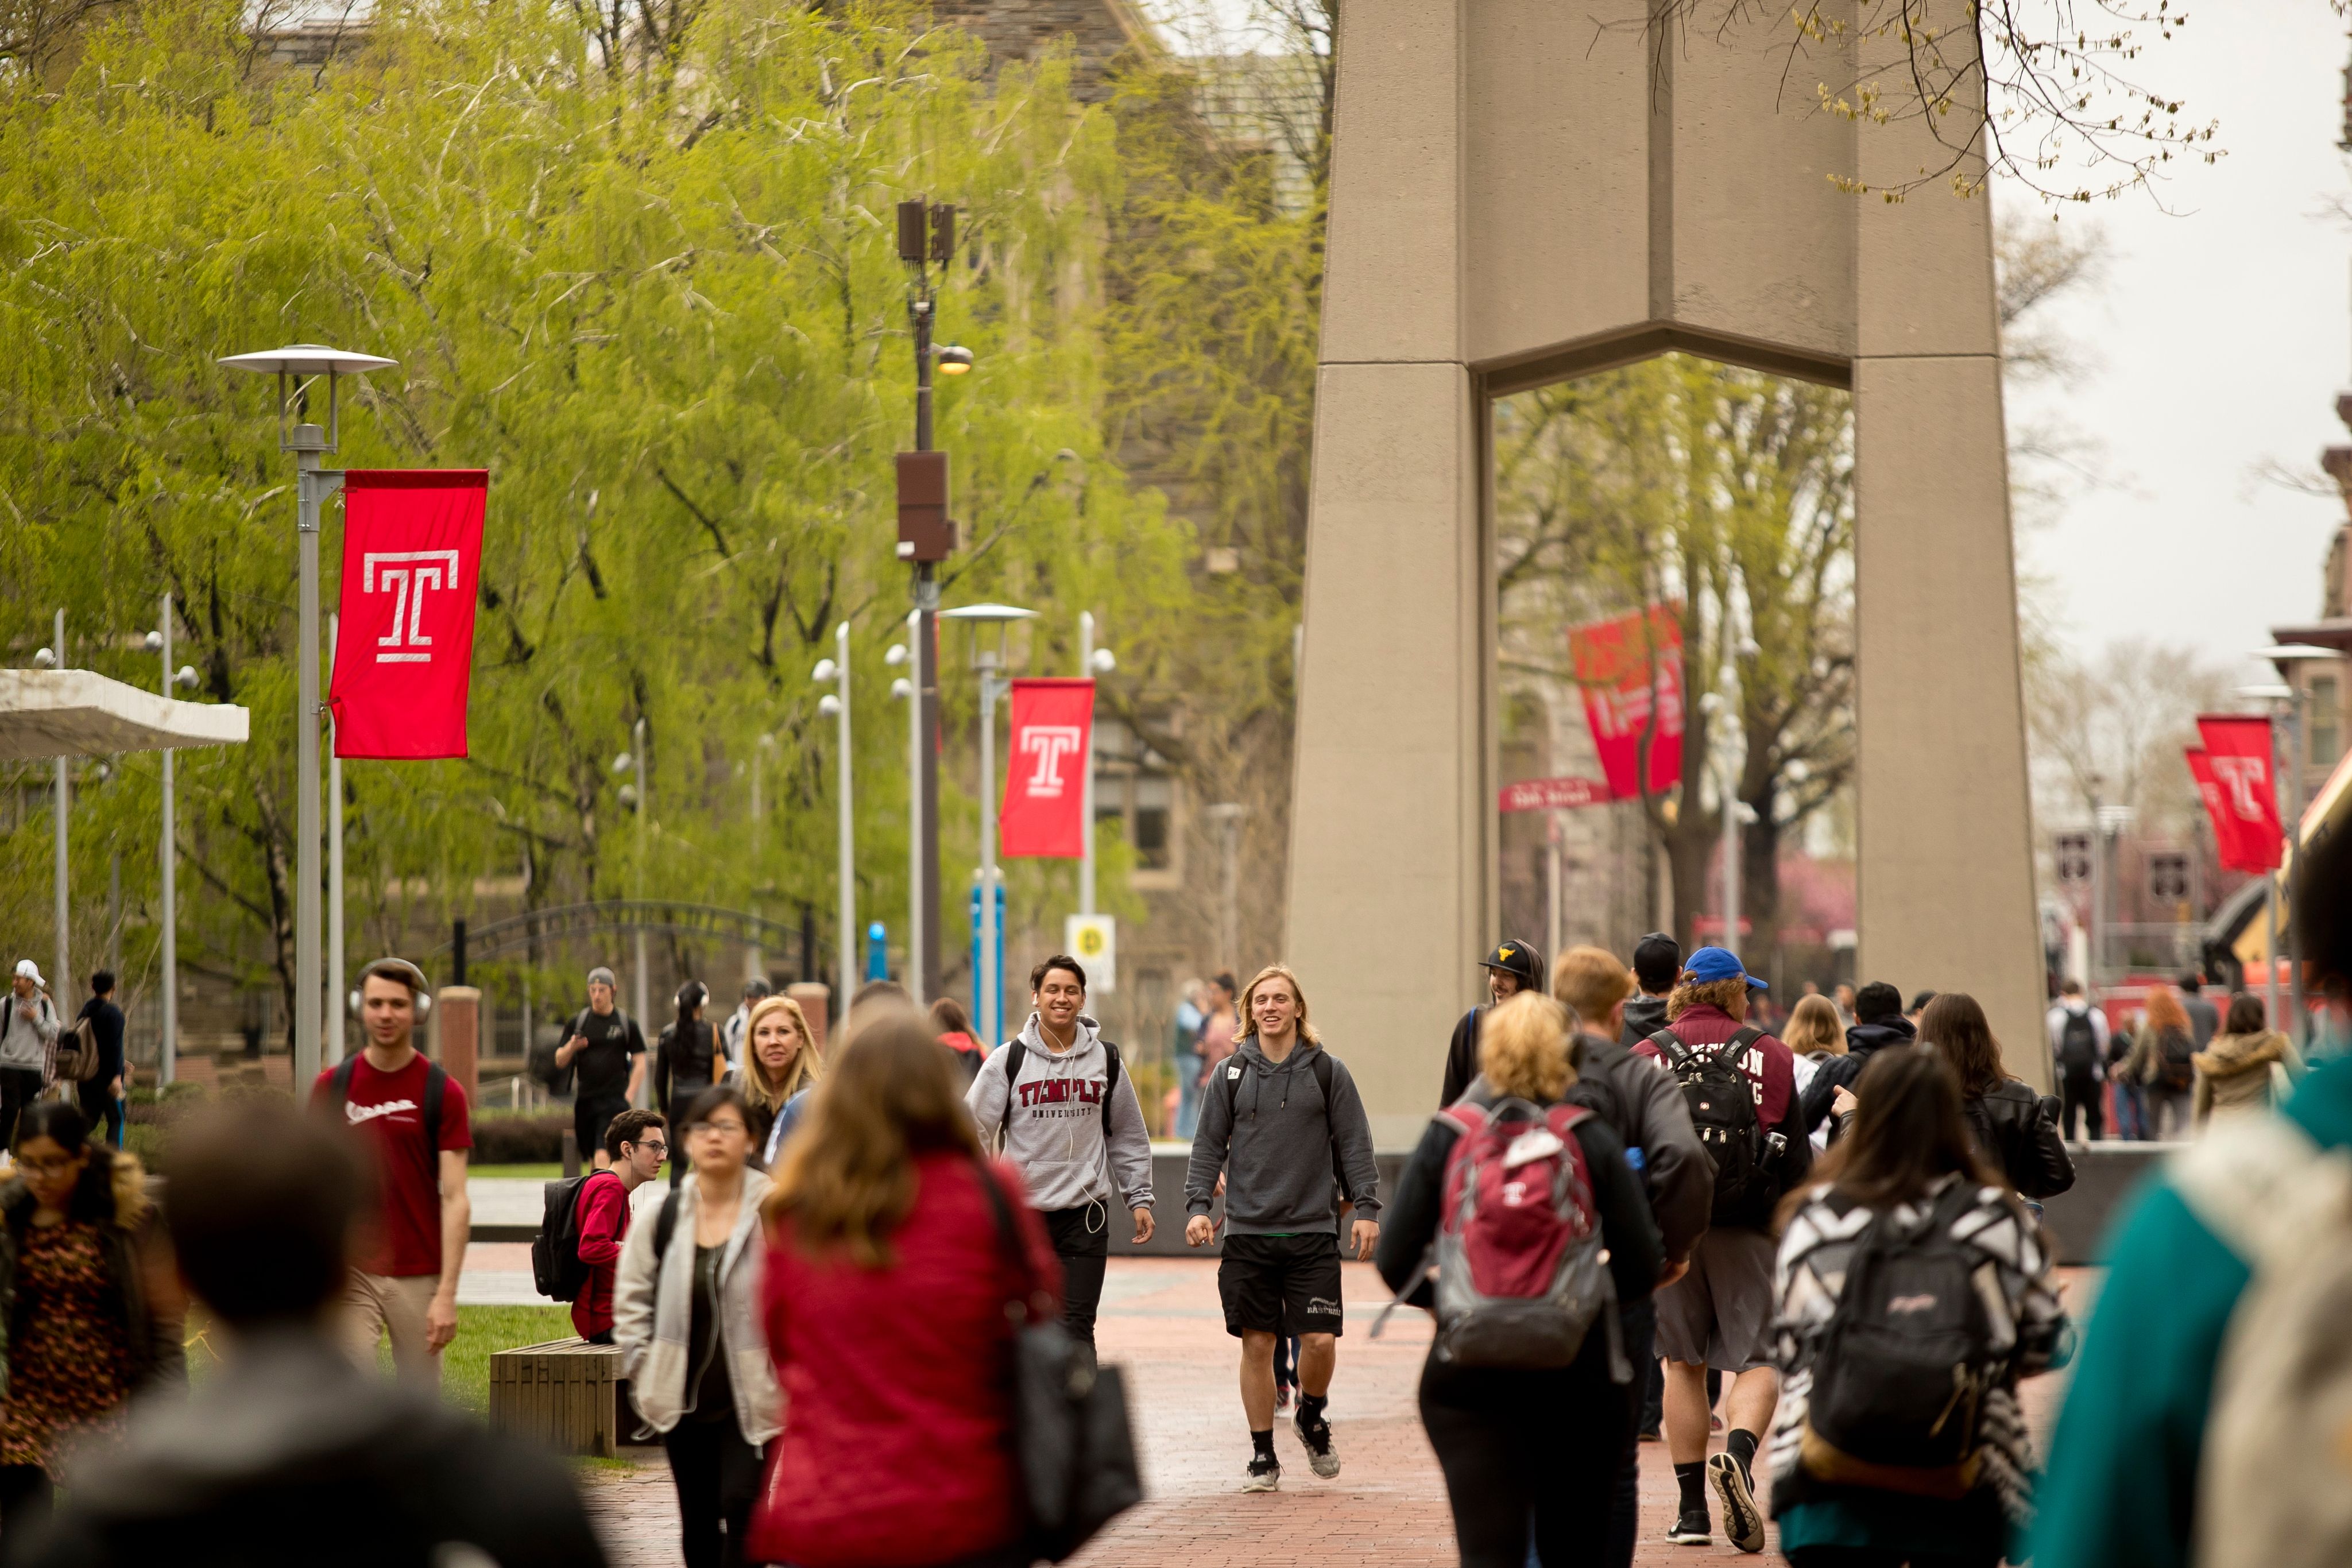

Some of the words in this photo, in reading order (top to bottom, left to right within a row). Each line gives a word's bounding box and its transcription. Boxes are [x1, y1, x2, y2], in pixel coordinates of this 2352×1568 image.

[363, 549, 459, 663] T
[1019, 1078, 1101, 1108] TEMPLE
[1032, 1107, 1092, 1118] UNIVERSITY
